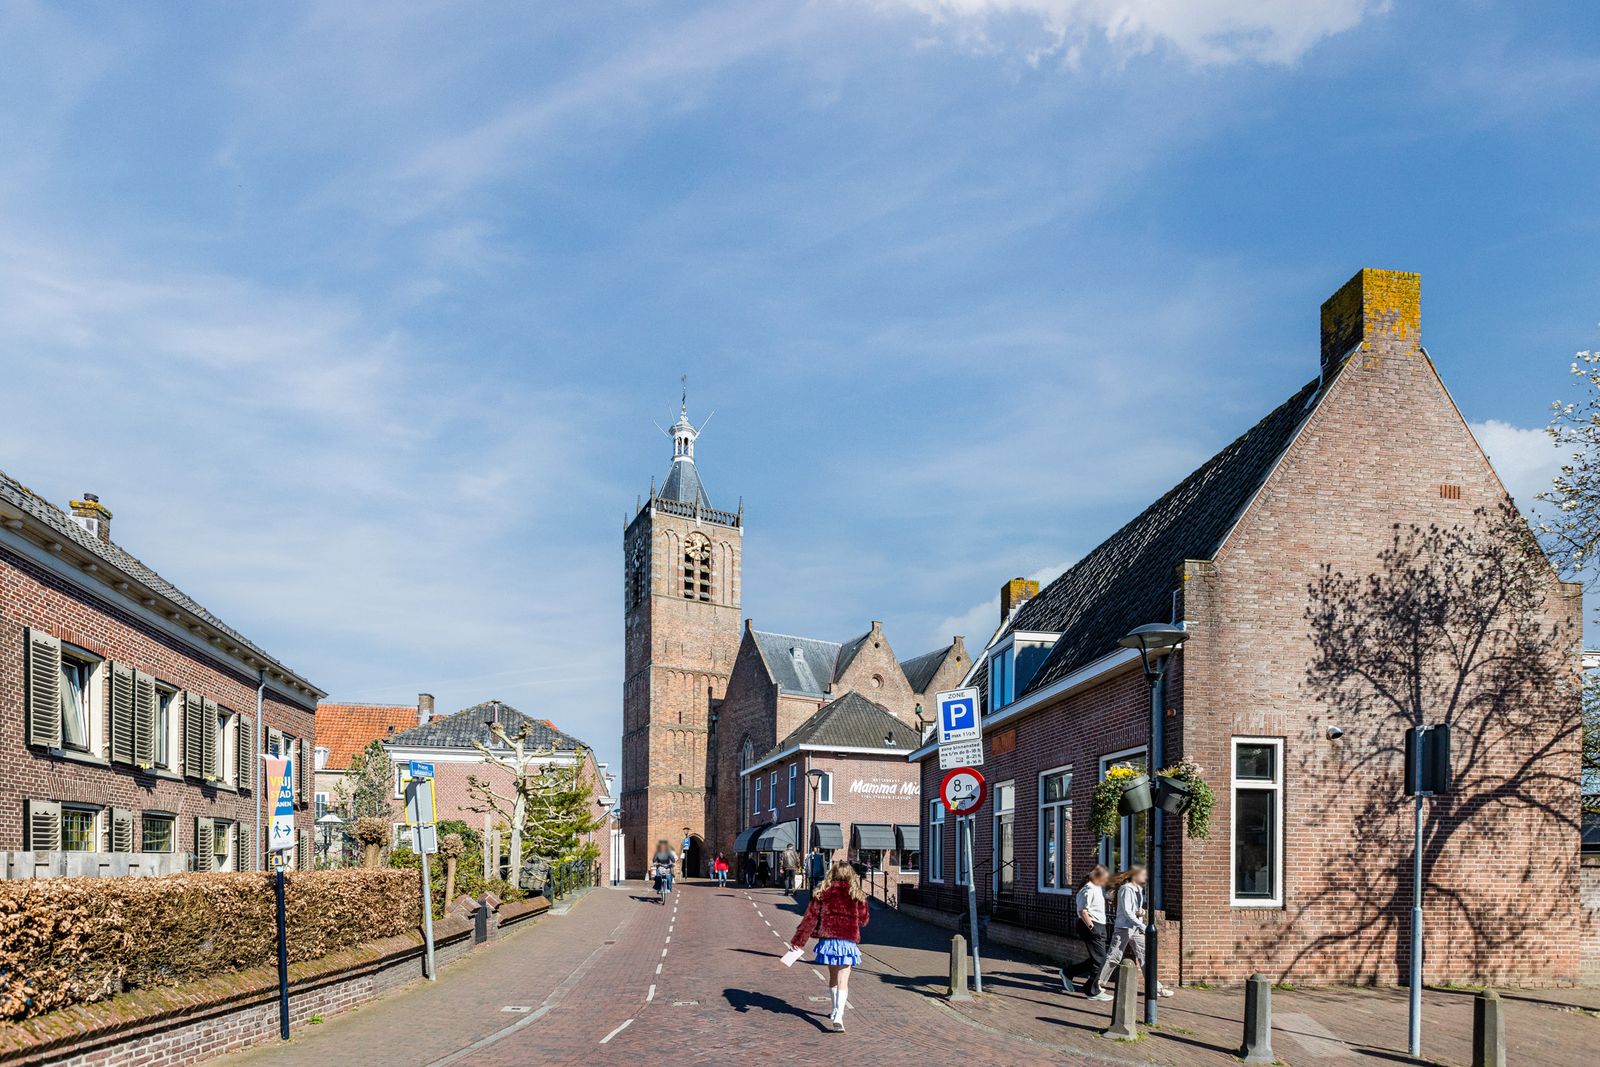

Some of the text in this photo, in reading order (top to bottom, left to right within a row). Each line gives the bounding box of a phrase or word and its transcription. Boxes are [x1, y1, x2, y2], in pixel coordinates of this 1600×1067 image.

[948, 691, 965, 699] ZONE
[950, 703, 967, 727] P
[270, 776, 291, 789] VRIJ
[850, 779, 920, 795] Mamma Mia
[954, 779, 962, 792] 8
[270, 790, 291, 799] STAD
